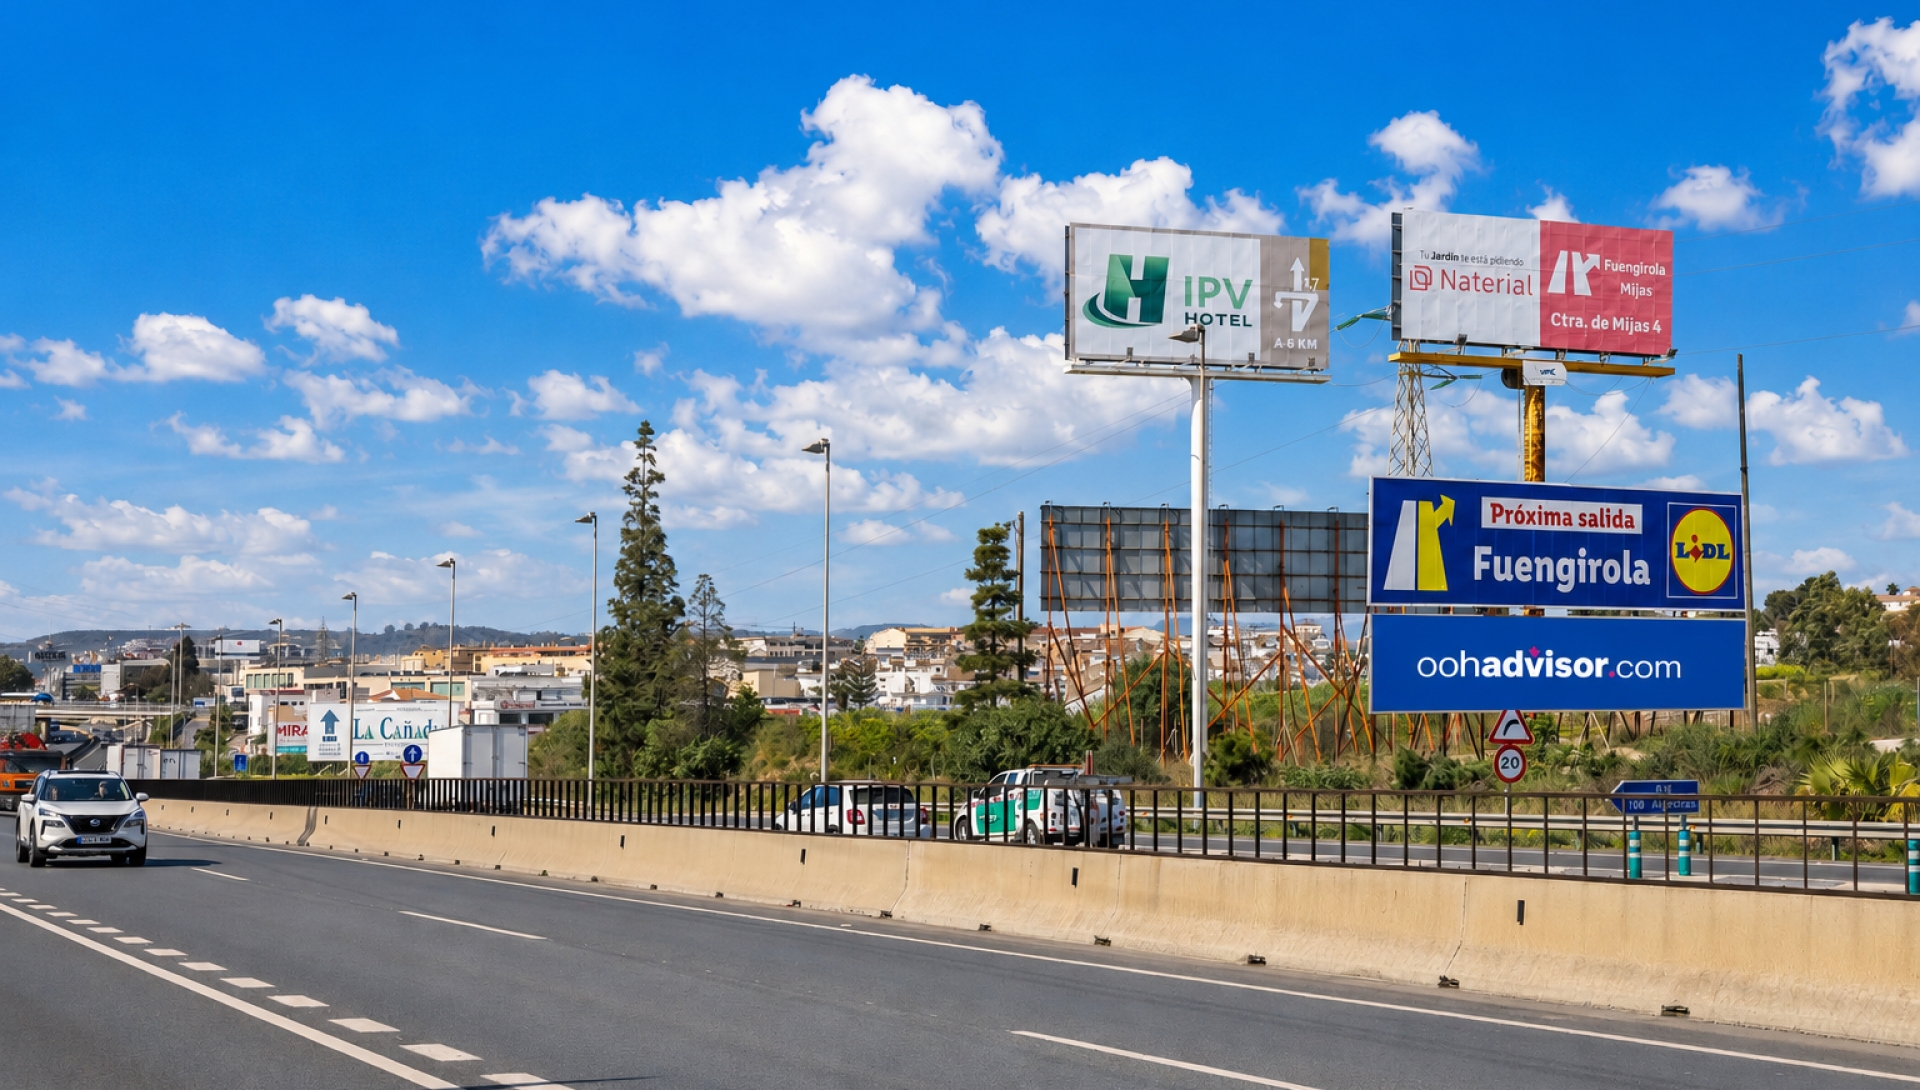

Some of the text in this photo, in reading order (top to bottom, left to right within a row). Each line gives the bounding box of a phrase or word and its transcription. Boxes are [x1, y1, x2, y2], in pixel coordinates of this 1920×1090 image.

[1461, 254, 1469, 263] te
[1604, 259, 1666, 277] Fuengirola
[1184, 275, 1254, 310] IPV
[1440, 268, 1533, 296] Naterial
[1620, 282, 1653, 300] Mijas
[1184, 312, 1253, 327] HOTEL
[1550, 312, 1662, 335] Ctra. de Mijas 4
[1298, 338, 1318, 350] KM
[1490, 502, 1635, 529] Próxima salida
[1474, 545, 1650, 594] Fuengirola
[1417, 648, 1682, 679] oohadvisor.com
[353, 716, 437, 740] La Cañad
[1500, 756, 1520, 770] 20
